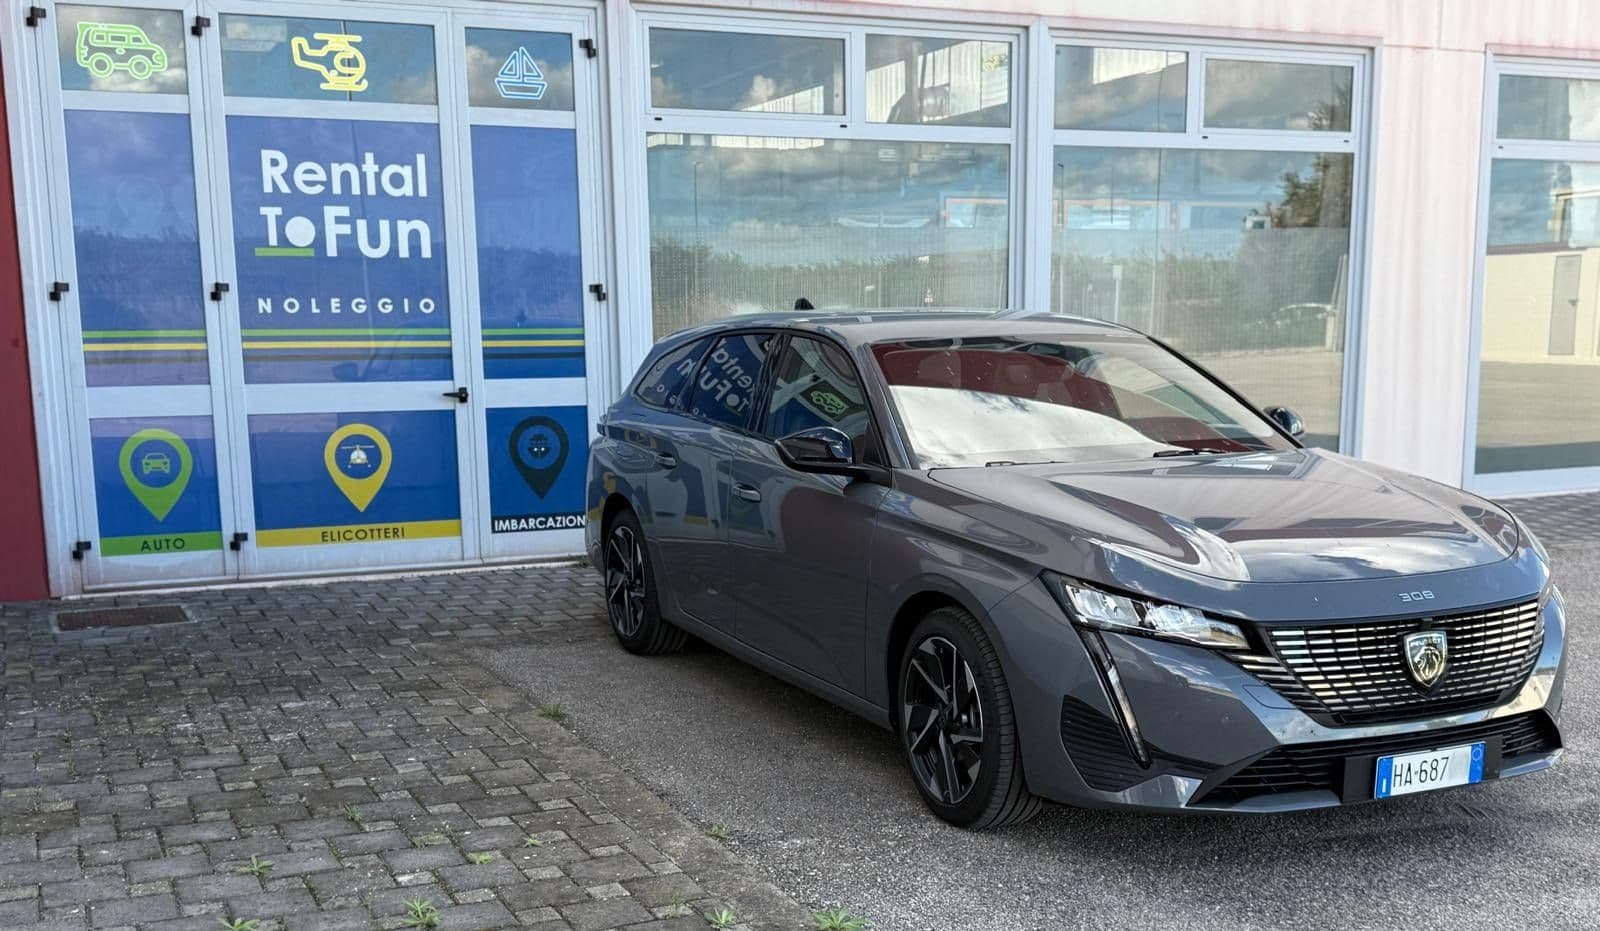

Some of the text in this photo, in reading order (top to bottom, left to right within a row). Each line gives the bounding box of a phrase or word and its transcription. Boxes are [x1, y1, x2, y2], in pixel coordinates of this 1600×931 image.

[261, 149, 428, 197] Rental
[258, 297, 435, 314] NOLEGGIO
[494, 515, 586, 531] IMBARCAZION
[320, 527, 406, 542] ELICOTTERI
[140, 537, 186, 552] AUTO
[1398, 590, 1436, 602] 308
